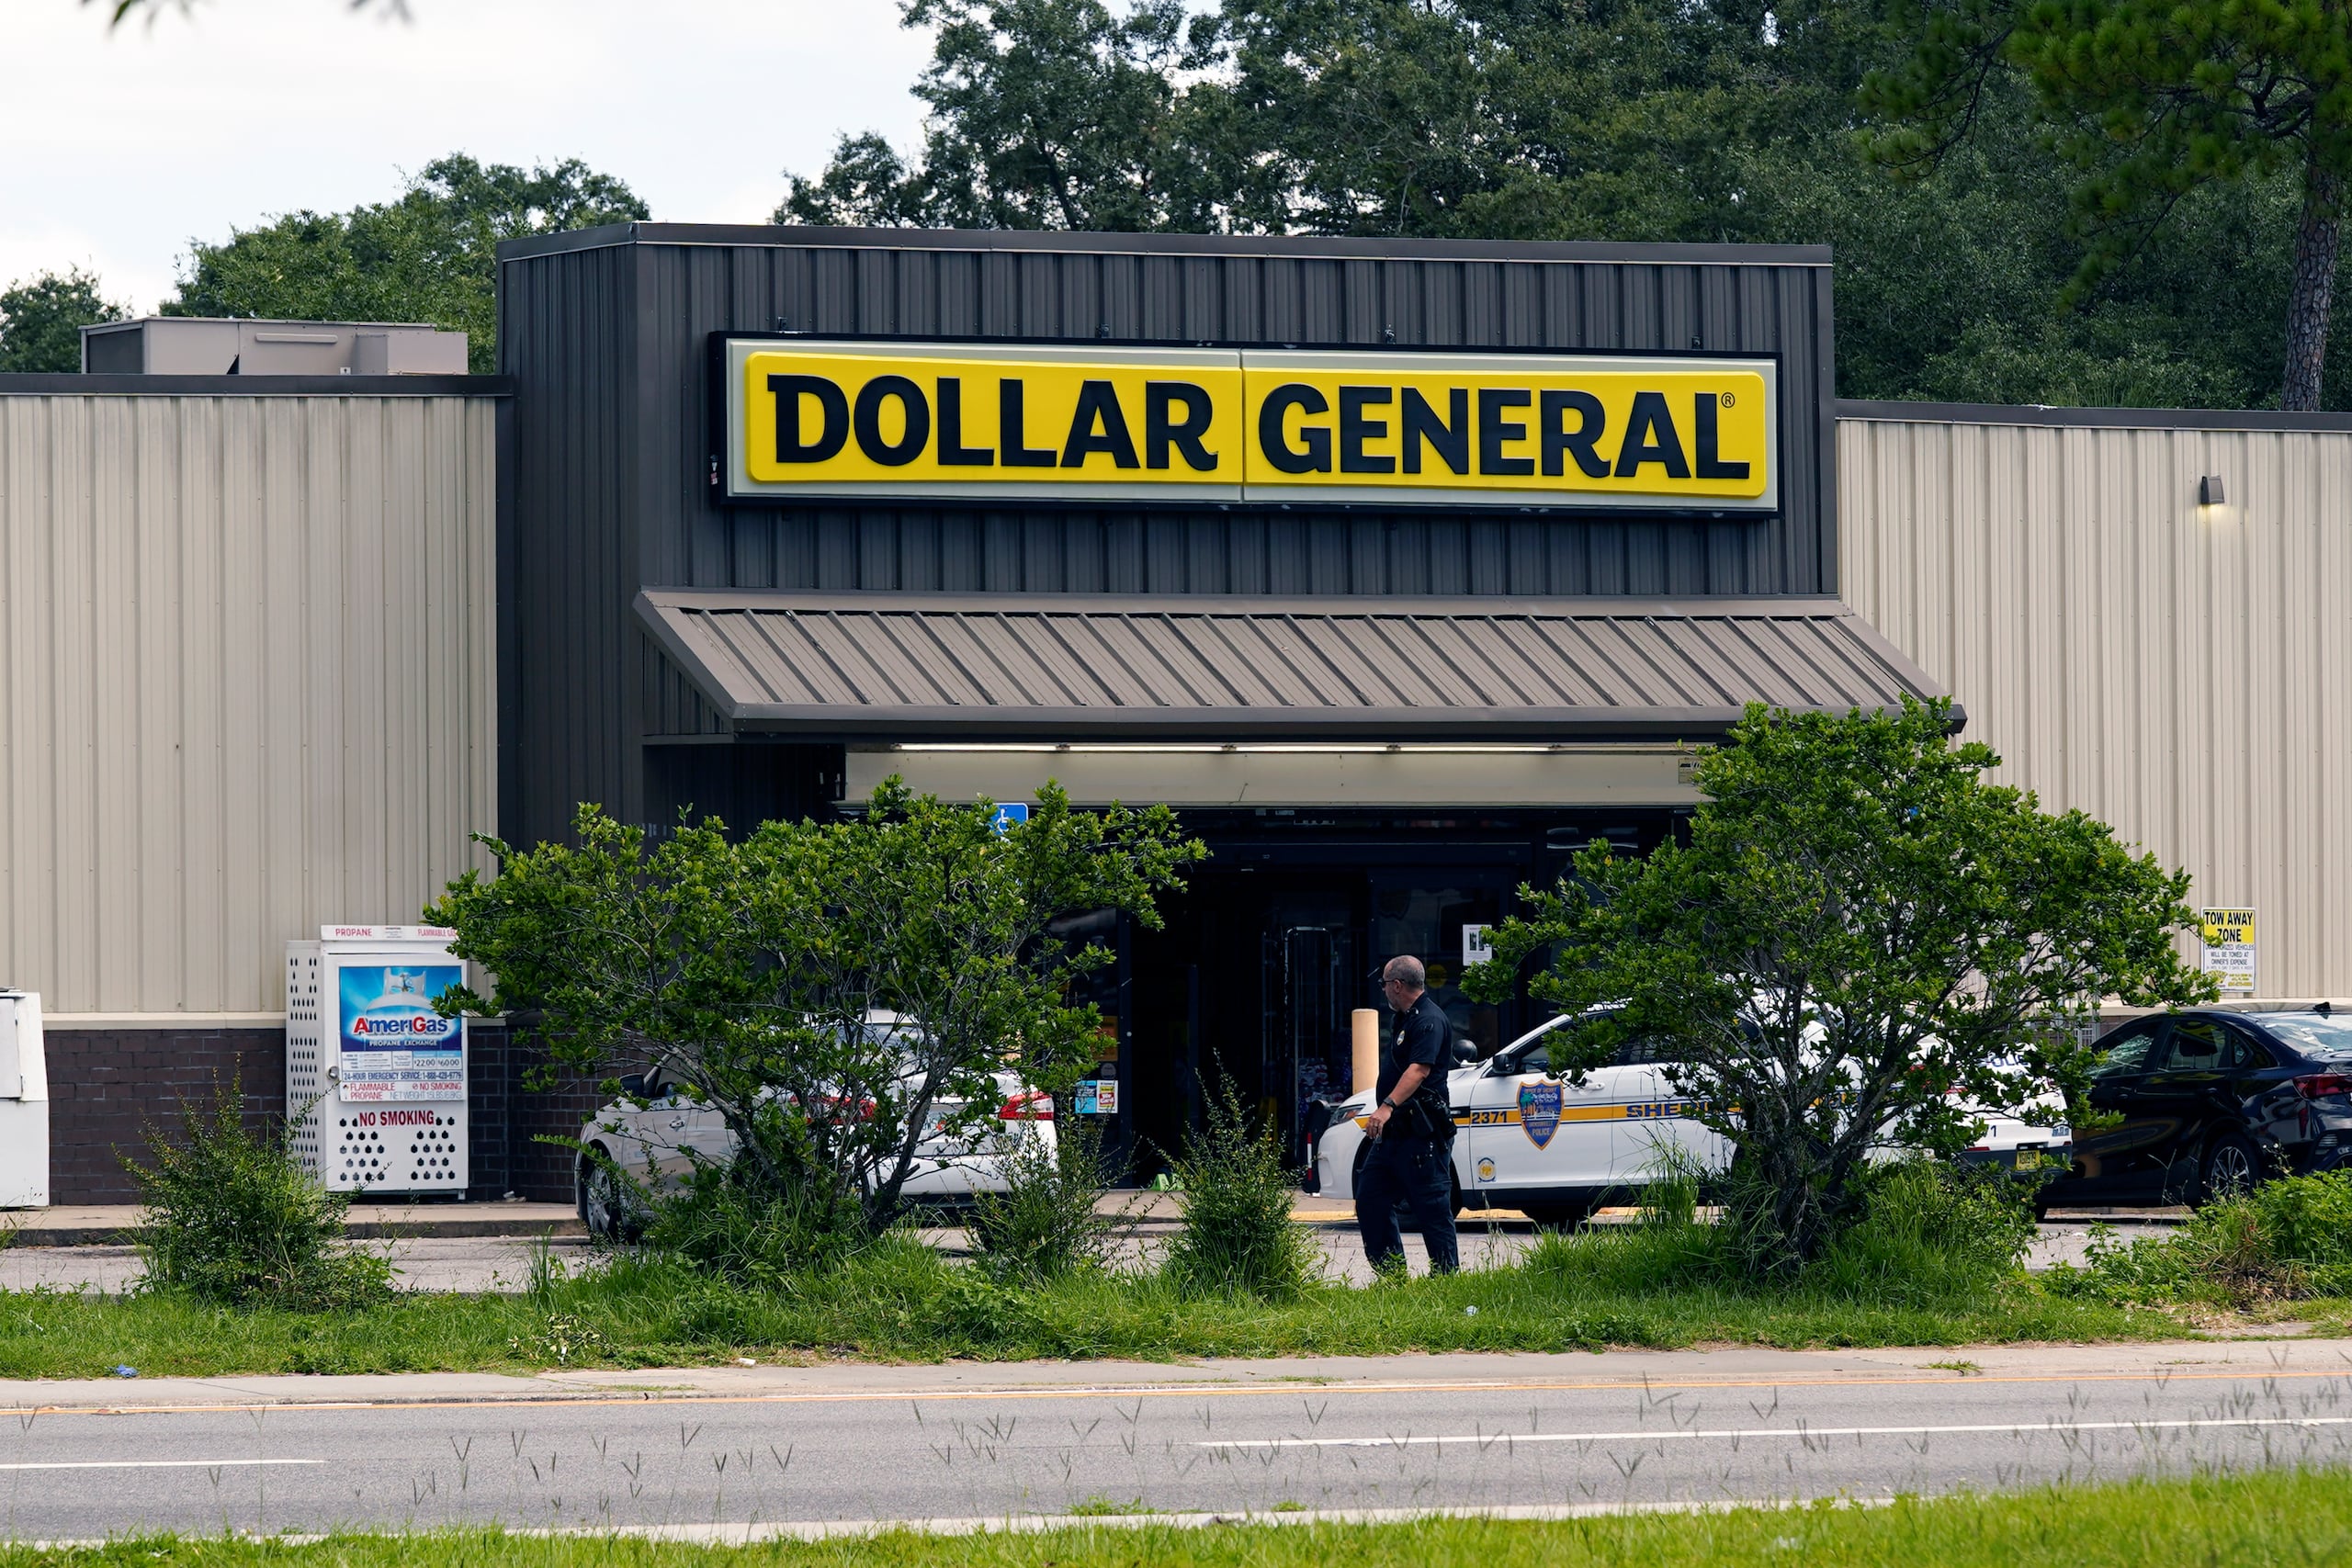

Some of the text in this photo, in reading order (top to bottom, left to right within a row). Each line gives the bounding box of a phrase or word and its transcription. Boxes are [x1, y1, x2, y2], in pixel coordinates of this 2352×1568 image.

[766, 373, 1218, 471] DOLLAR
[1258, 383, 1749, 479] GENERAL
[2205, 911, 2253, 926] TOW AWAY
[335, 928, 372, 937] PROPANE
[418, 928, 447, 937] FLAMMABLE
[354, 1016, 448, 1033] AmeriGas
[368, 1072, 399, 1080] EMERGENCY
[350, 1082, 395, 1091] FLAMMABLE
[419, 1082, 462, 1090] NO SMOKING
[350, 1091, 382, 1100] PROPANE
[358, 1110, 435, 1127] NO SMOKING
[1471, 1111, 1508, 1123] 2371
